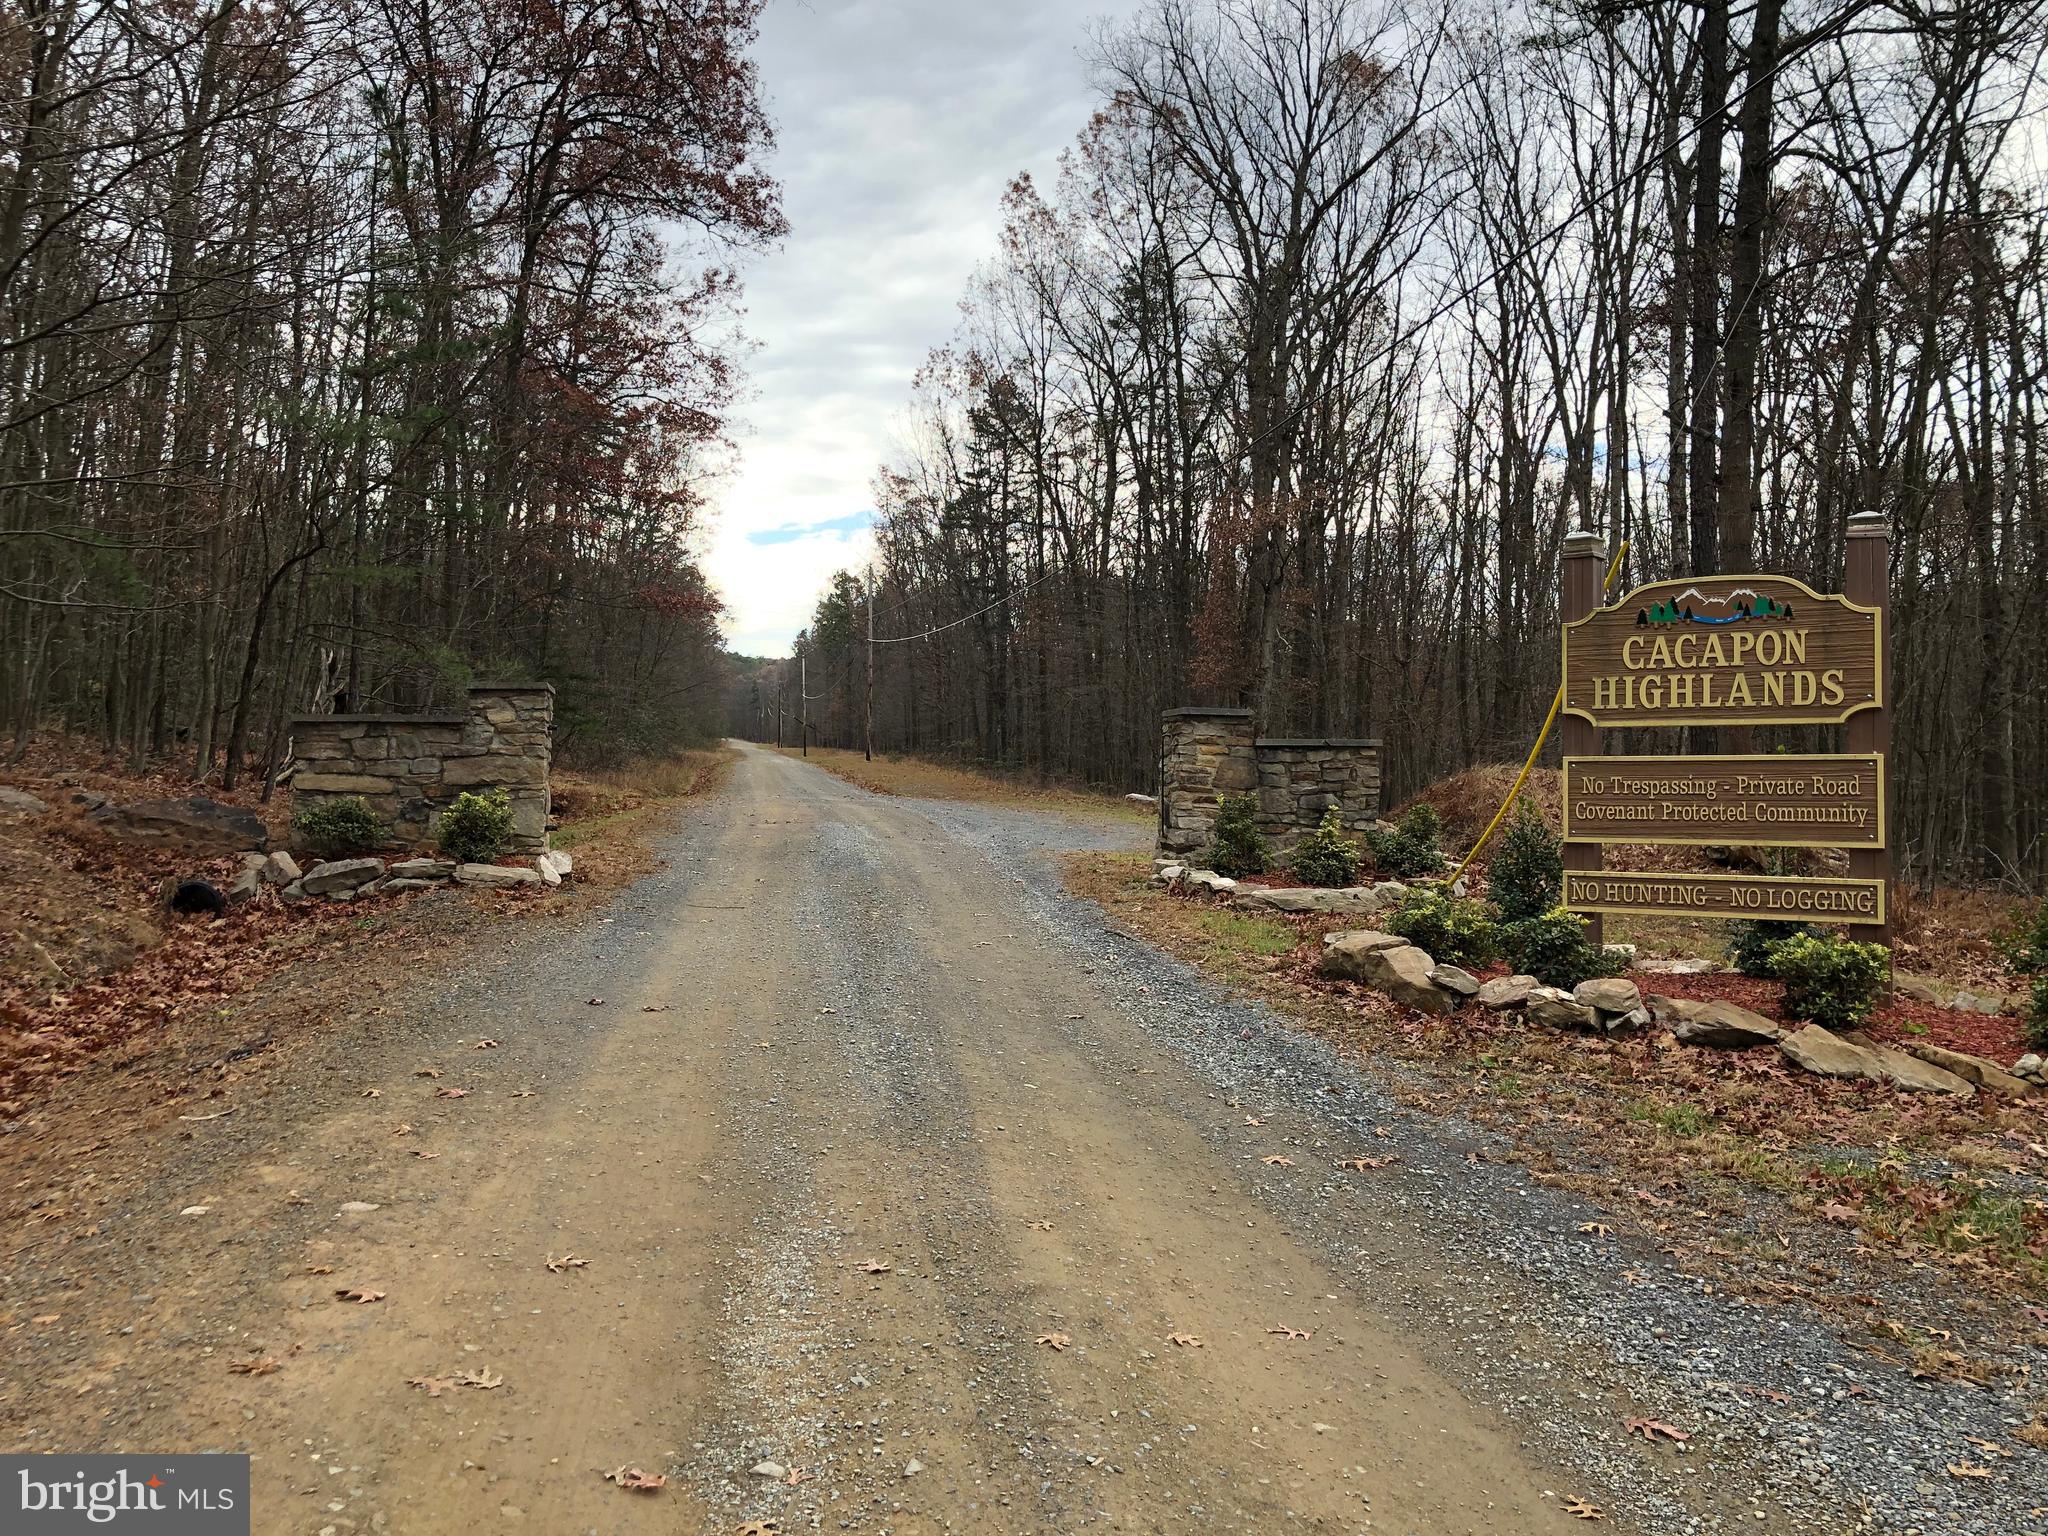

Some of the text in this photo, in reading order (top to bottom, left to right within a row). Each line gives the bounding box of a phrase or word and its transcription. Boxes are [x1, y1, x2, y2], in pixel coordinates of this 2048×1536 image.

[1622, 629, 1809, 670] CACAPON
[1591, 669, 1845, 710] HIGHLANDS
[1581, 776, 1604, 795] No
[1610, 775, 1717, 799] Trespassing
[1736, 775, 1805, 796] Private
[1811, 775, 1861, 796] Road
[1575, 802, 1869, 828] Covenant Protected Community
[1571, 881, 1600, 901] NO
[1604, 882, 1707, 905] HUNTING
[1730, 887, 1761, 908] NO
[1766, 888, 1872, 912] LOGGING
